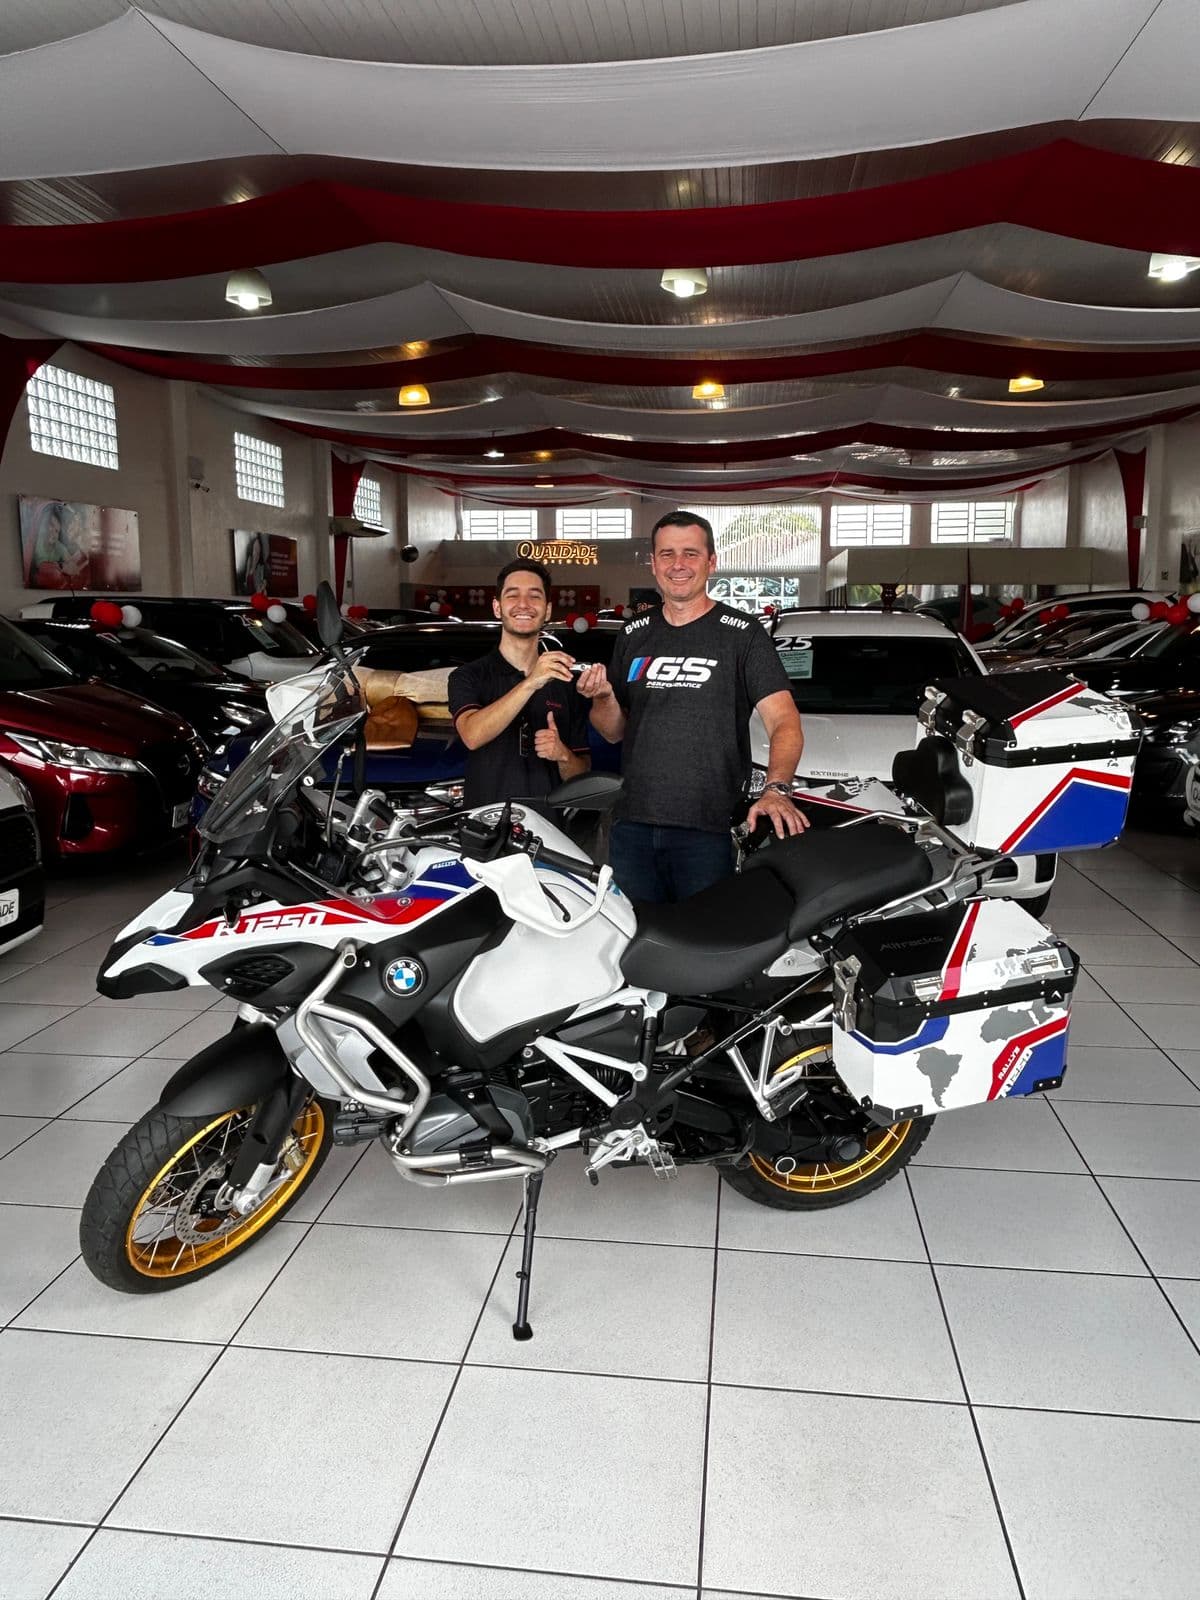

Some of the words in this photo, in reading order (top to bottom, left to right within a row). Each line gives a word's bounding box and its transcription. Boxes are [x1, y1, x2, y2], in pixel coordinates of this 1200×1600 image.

[625, 616, 650, 634] BMW
[720, 614, 750, 630] BMW
[775, 636, 812, 651] 25
[646, 656, 718, 682] GS
